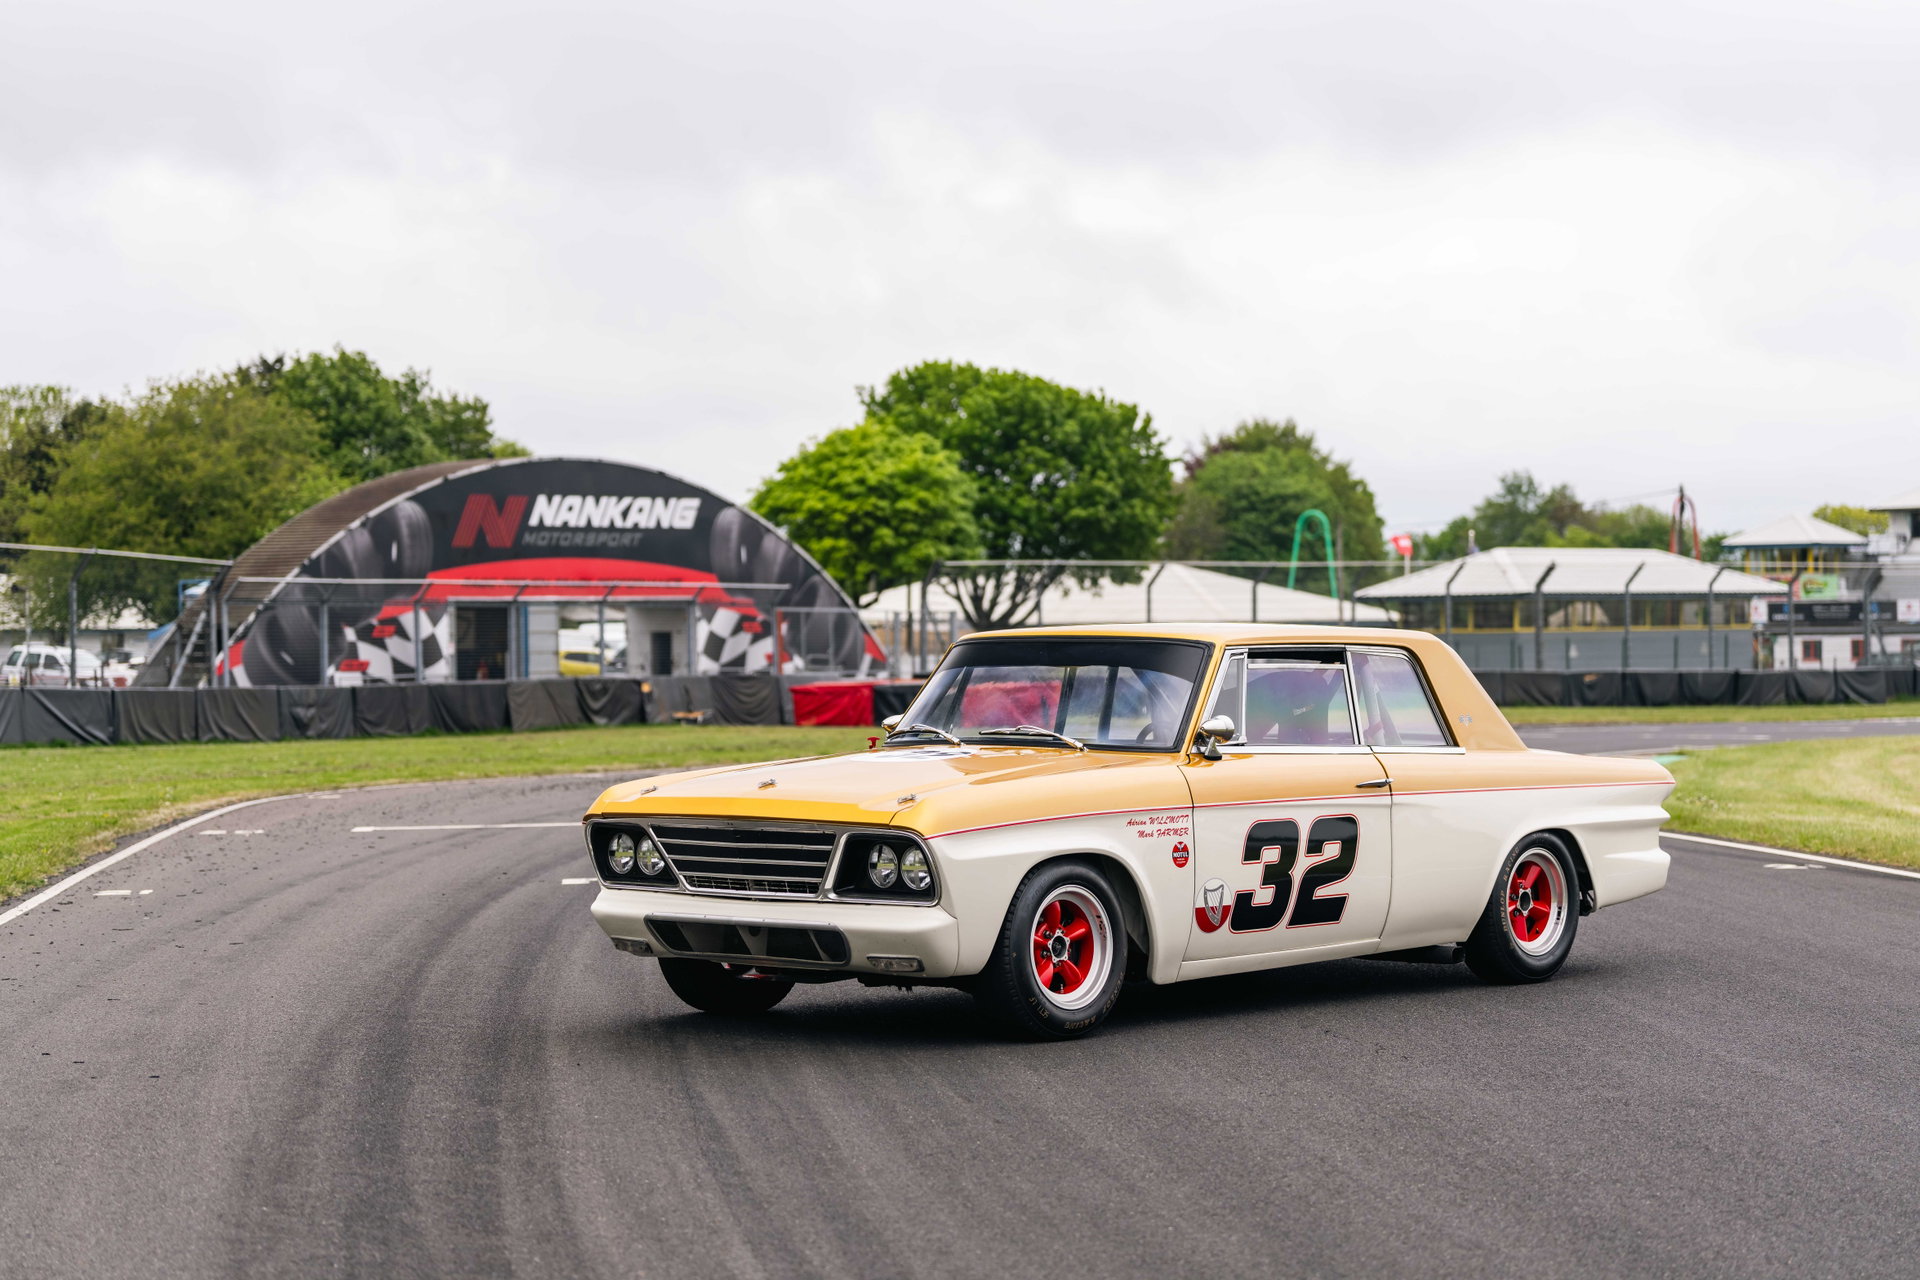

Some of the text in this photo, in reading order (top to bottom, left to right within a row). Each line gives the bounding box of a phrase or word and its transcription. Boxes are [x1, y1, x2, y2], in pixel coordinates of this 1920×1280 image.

[528, 494, 702, 530] NANKANG
[522, 531, 643, 548] MOTORSPORT
[1126, 814, 1190, 827] Adrian WILLMOTT
[1137, 827, 1190, 838] Mark FARMER
[1228, 813, 1360, 934] 32
